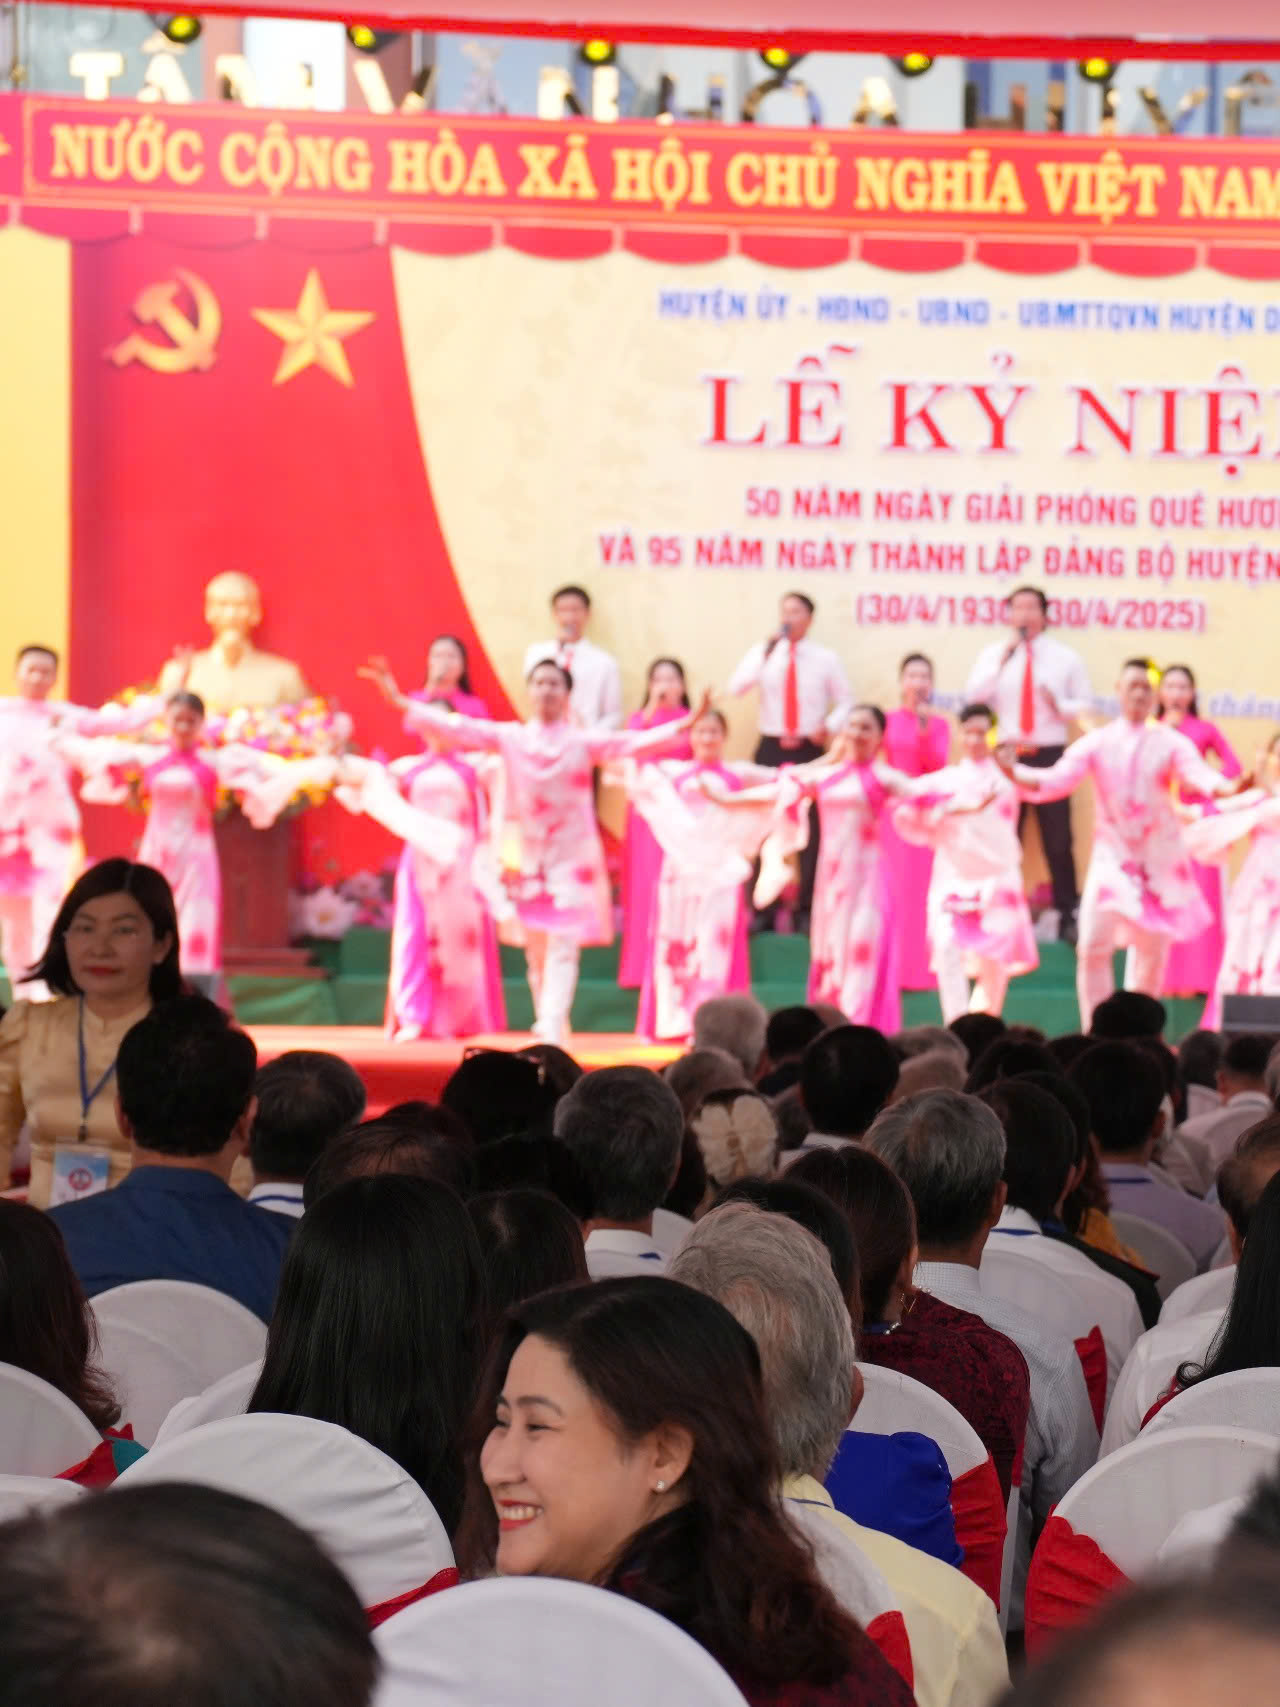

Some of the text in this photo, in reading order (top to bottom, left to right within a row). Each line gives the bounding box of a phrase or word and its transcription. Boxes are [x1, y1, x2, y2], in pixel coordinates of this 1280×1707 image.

[50, 114, 205, 185] NƯỚC
[219, 120, 373, 198] CỘNG
[387, 127, 508, 196] HÒA
[517, 133, 598, 200] XÃ
[611, 135, 712, 213] HỘI
[725, 140, 839, 209] CHỦ
[854, 148, 1028, 215] NGHĨA
[1036, 149, 1166, 226] VIỆT
[658, 287, 748, 326] HUYỆN
[917, 298, 990, 325] UBND
[1168, 301, 1256, 336] HUYỆN
[702, 342, 860, 448] LỄ
[883, 351, 1034, 454] KỶ
[745, 487, 782, 518] 50
[793, 484, 862, 520] NĂM
[873, 486, 953, 522] NGÀY
[964, 484, 1024, 524] GIẢI
[1035, 489, 1137, 527] PHÓNG
[1148, 493, 1208, 529] QUÊ
[599, 530, 636, 566] VÀ
[647, 536, 682, 567] 95
[695, 532, 763, 568] NĂM
[777, 536, 857, 571] NGÀY
[870, 536, 966, 574] THÀNH
[1043, 536, 1125, 578] ĐẢNG
[1136, 542, 1176, 585] BỘ
